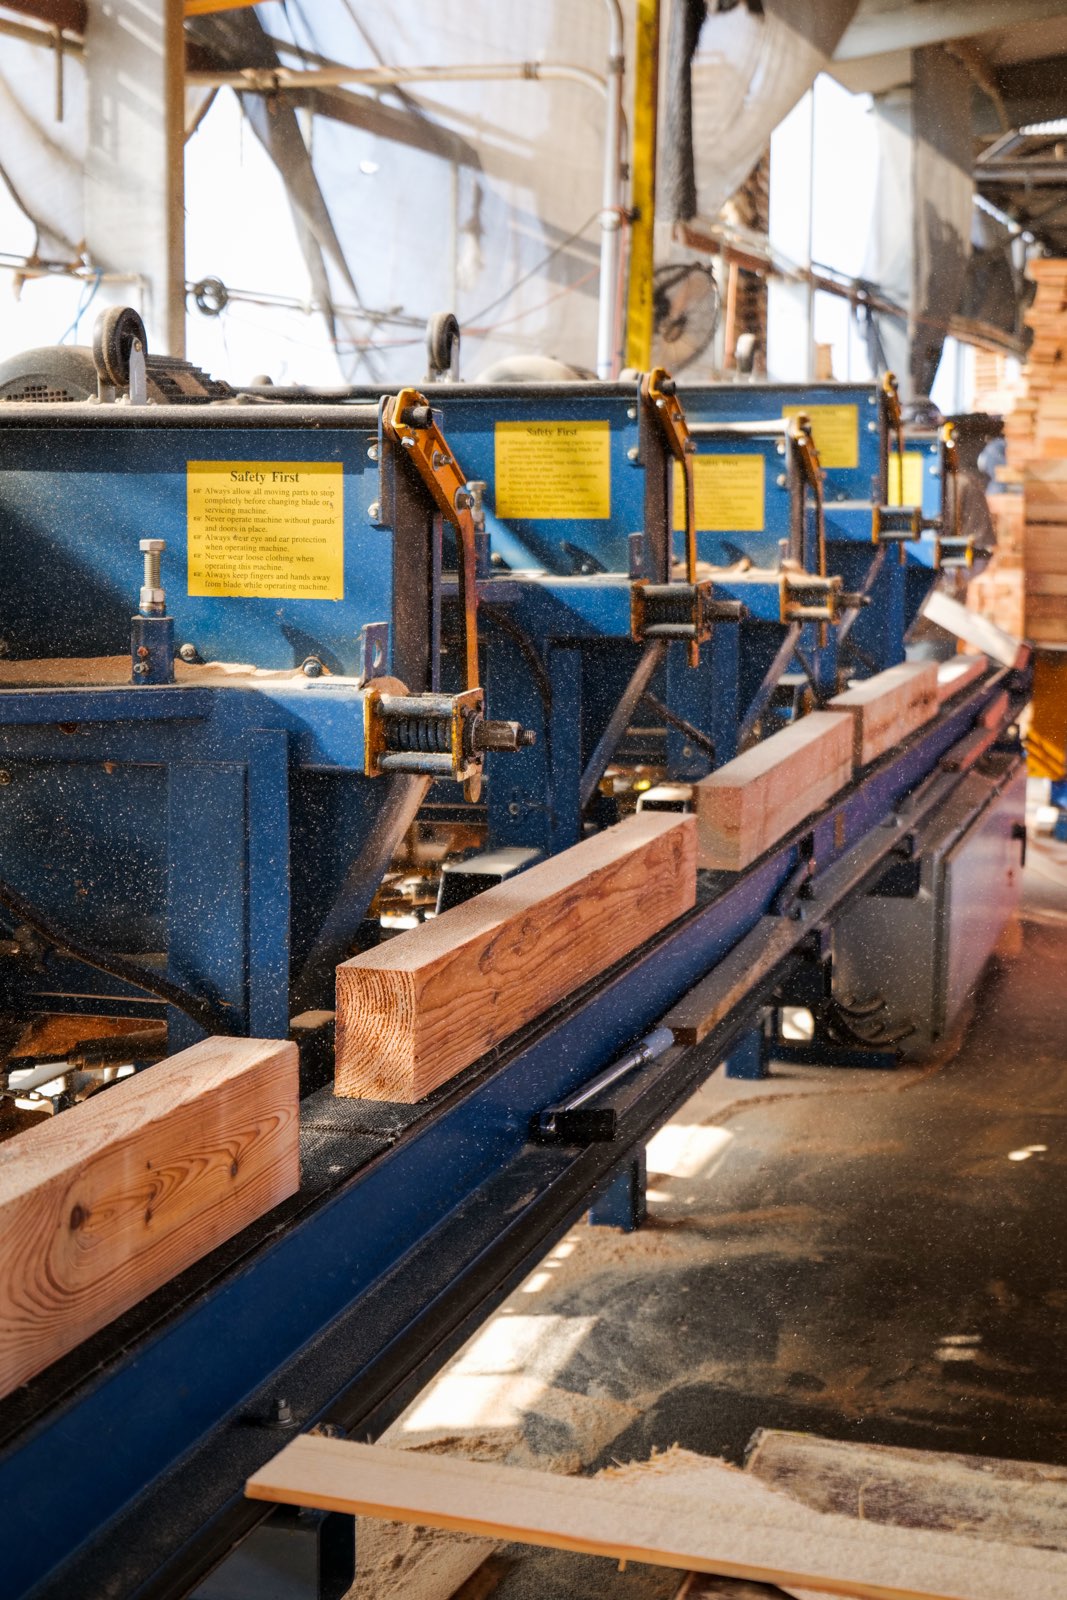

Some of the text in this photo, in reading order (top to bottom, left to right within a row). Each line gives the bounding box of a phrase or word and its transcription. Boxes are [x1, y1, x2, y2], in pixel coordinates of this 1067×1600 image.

[527, 427, 577, 437] Safety First
[230, 471, 299, 485] Safety First
[205, 488, 230, 496] Always
[264, 489, 289, 497] moving
[268, 498, 298, 506] changing
[227, 516, 251, 524] operate
[205, 534, 230, 542] Always
[292, 536, 326, 544] protection
[266, 555, 293, 563] clothing
[205, 563, 236, 571] operating
[233, 572, 248, 580] keep
[250, 573, 273, 581] fingers
[264, 583, 296, 591] operating
